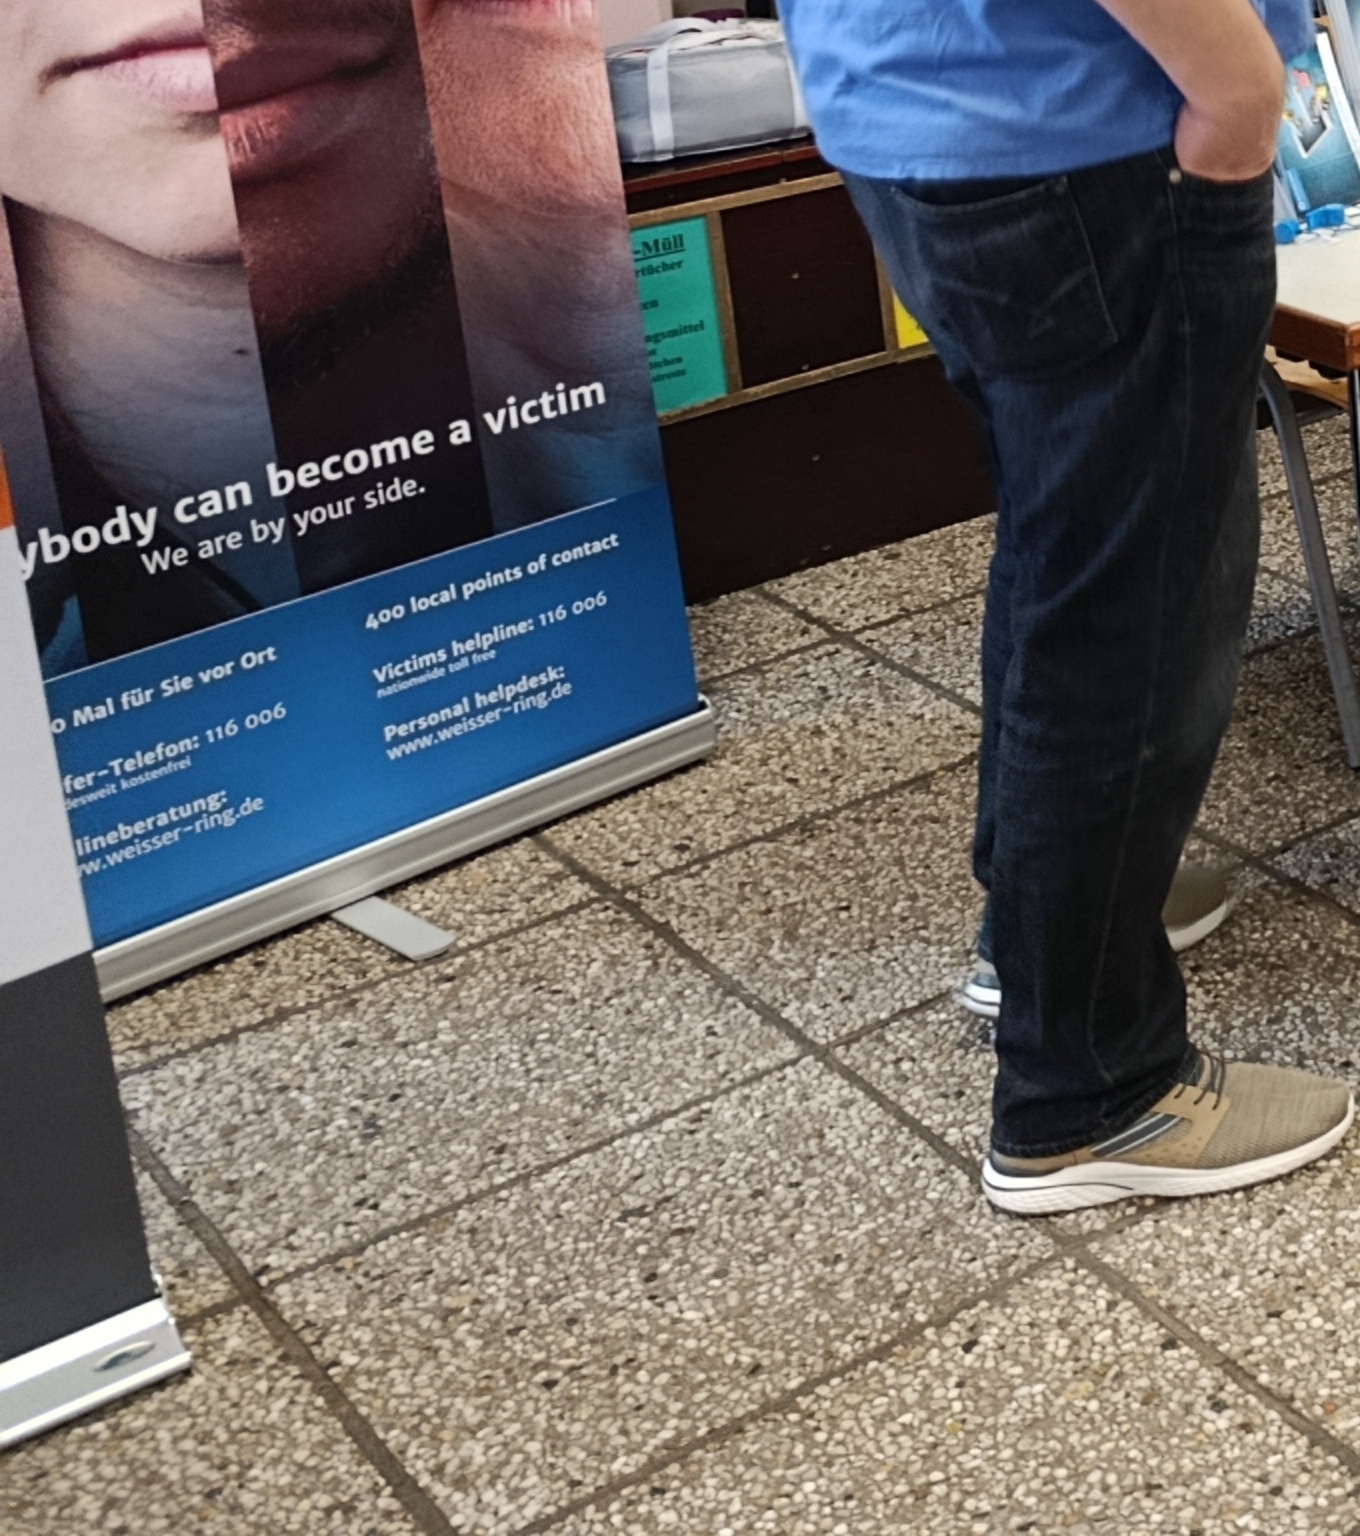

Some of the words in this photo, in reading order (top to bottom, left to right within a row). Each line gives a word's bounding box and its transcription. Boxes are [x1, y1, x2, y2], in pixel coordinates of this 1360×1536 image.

[174, 481, 253, 524] can
[266, 429, 435, 497] become
[448, 418, 472, 446] a
[483, 380, 606, 435] victim
[140, 546, 190, 575] We
[198, 530, 243, 560] are
[250, 517, 286, 544] by
[293, 496, 355, 537] your
[363, 477, 426, 510] side.
[365, 604, 405, 629] 400
[409, 584, 457, 613] local
[462, 566, 522, 600] points
[527, 554, 548, 574] of
[551, 533, 619, 566] contact
[373, 648, 447, 683] Victims
[452, 618, 534, 657] helpline:
[538, 605, 567, 626] 116
[571, 590, 607, 614] 006
[377, 665, 445, 698] nationwide
[448, 658, 469, 673] toll
[472, 649, 496, 665] free
[73, 698, 115, 727] Mal
[121, 687, 154, 710] für
[160, 675, 193, 697] Sie
[199, 661, 235, 683] vor
[241, 646, 277, 669] Ort
[205, 718, 238, 743] 116
[245, 702, 287, 729] 006
[384, 697, 470, 742] Personal
[475, 666, 565, 710] helpdesk:
[386, 681, 572, 761] www.weisser-ring.de
[121, 756, 192, 790] kostenfrei
